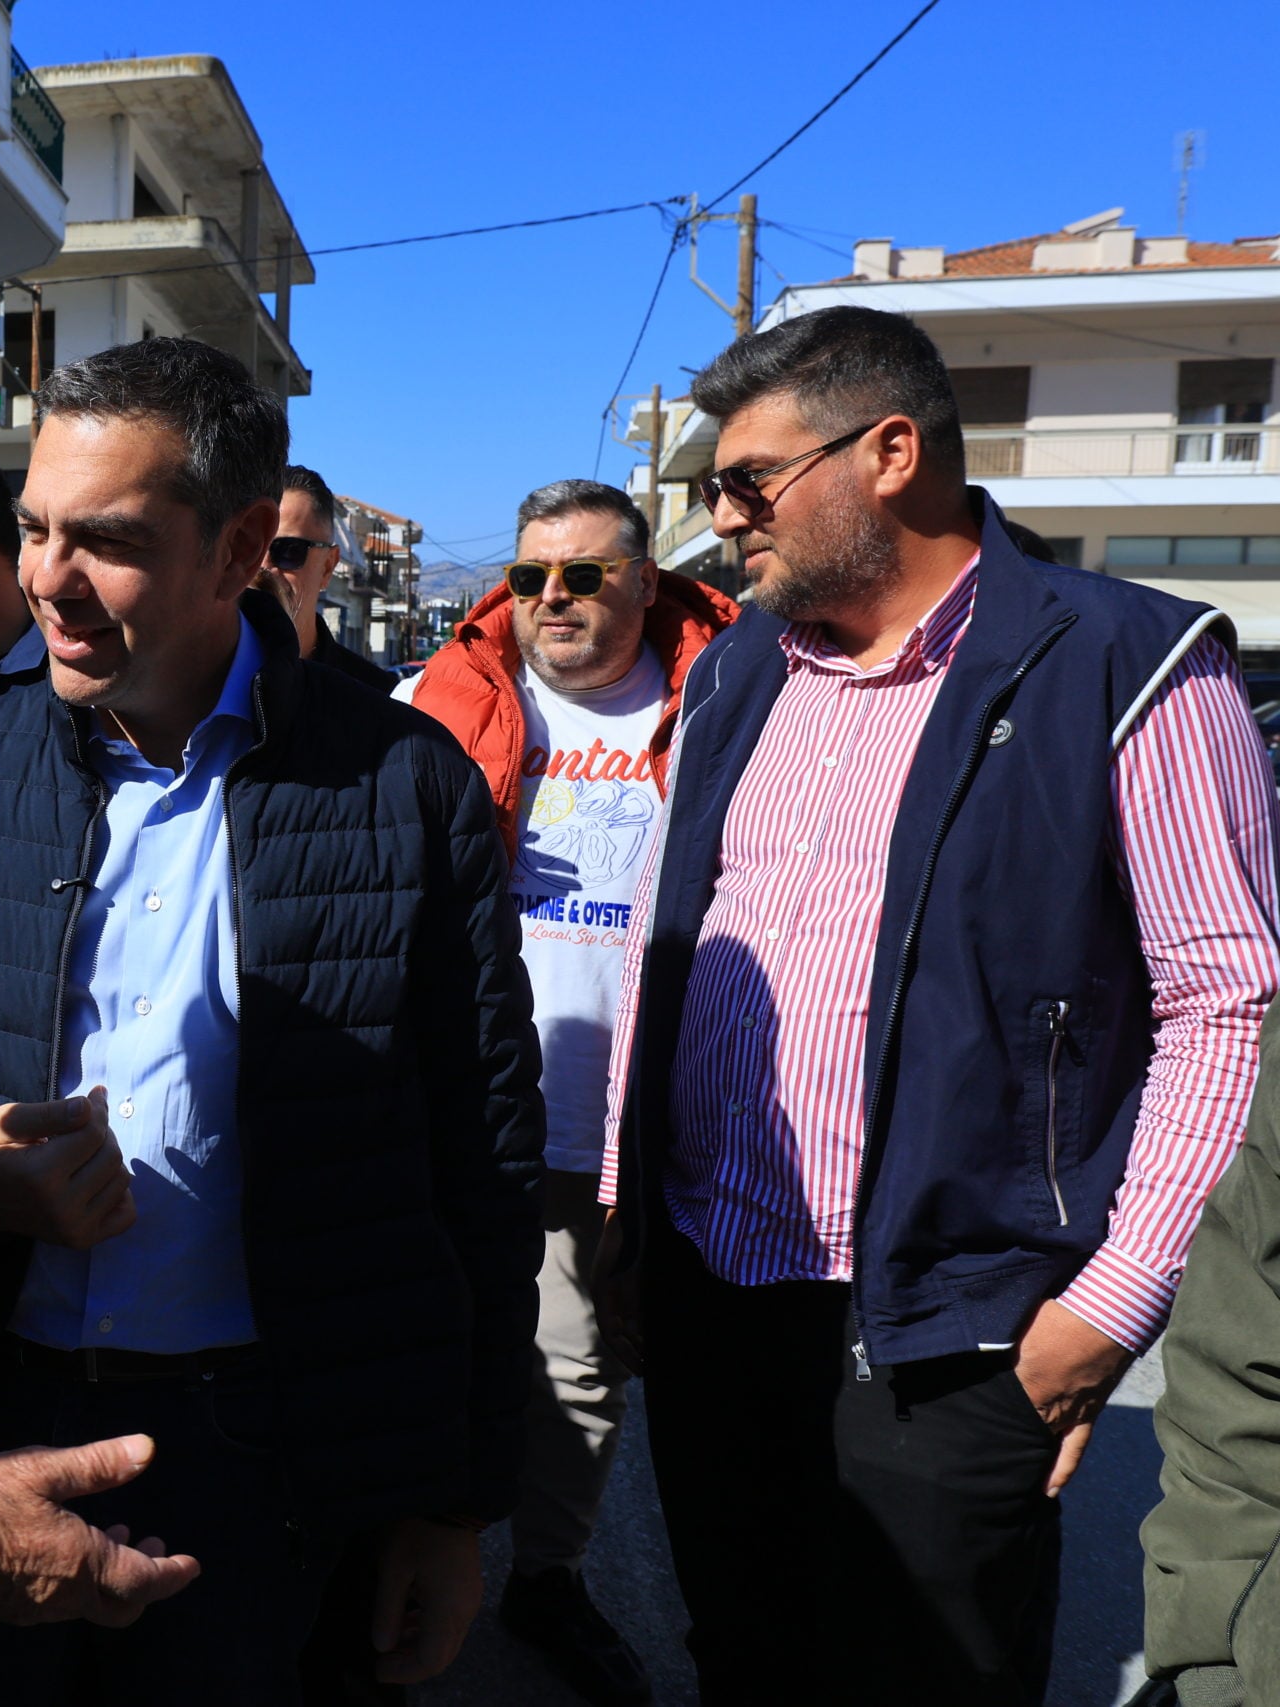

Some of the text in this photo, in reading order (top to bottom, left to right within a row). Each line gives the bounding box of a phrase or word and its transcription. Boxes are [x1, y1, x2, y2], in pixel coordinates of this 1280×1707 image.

[526, 894, 565, 922] WINE
[568, 899, 580, 924] &
[583, 900, 631, 929] OYSTE
[527, 923, 572, 942] Local,
[572, 928, 598, 947] Sip
